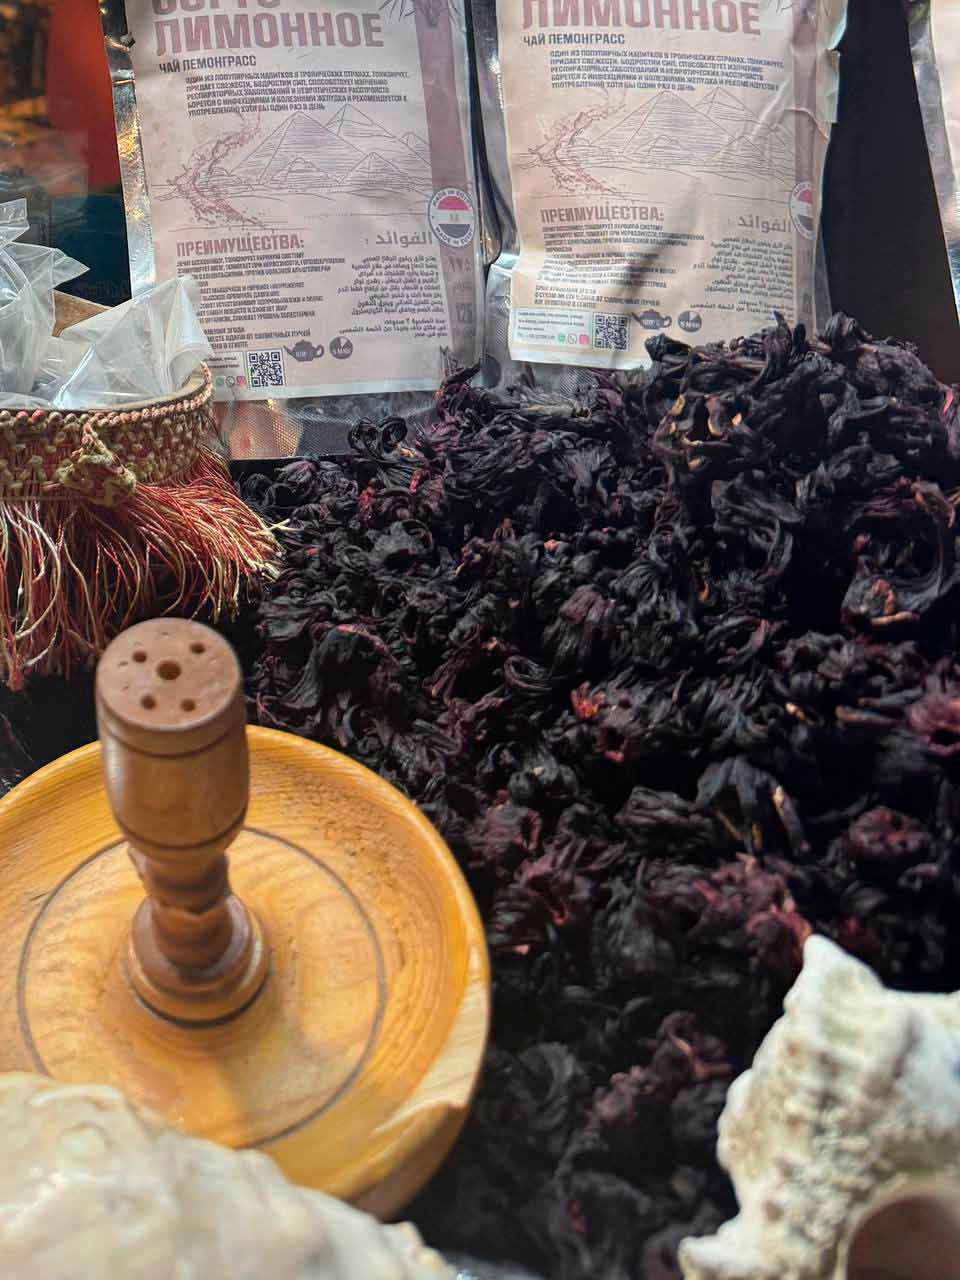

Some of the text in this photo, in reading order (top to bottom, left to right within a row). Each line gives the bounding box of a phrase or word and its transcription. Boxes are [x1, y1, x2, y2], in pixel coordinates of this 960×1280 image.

[152, 10, 385, 56] ЛИМОННОЕ
[523, 31, 626, 47] ЧАЙ ЛЕМОНГРАСС
[158, 54, 257, 74] ЧАЙ ЛЕМОНГРАСС
[540, 204, 665, 223] ПРЕИМУЩЕСТВА:
[176, 233, 305, 258] ПРЕИМУЩЕСТВА:
[376, 230, 433, 249] الفوائد
